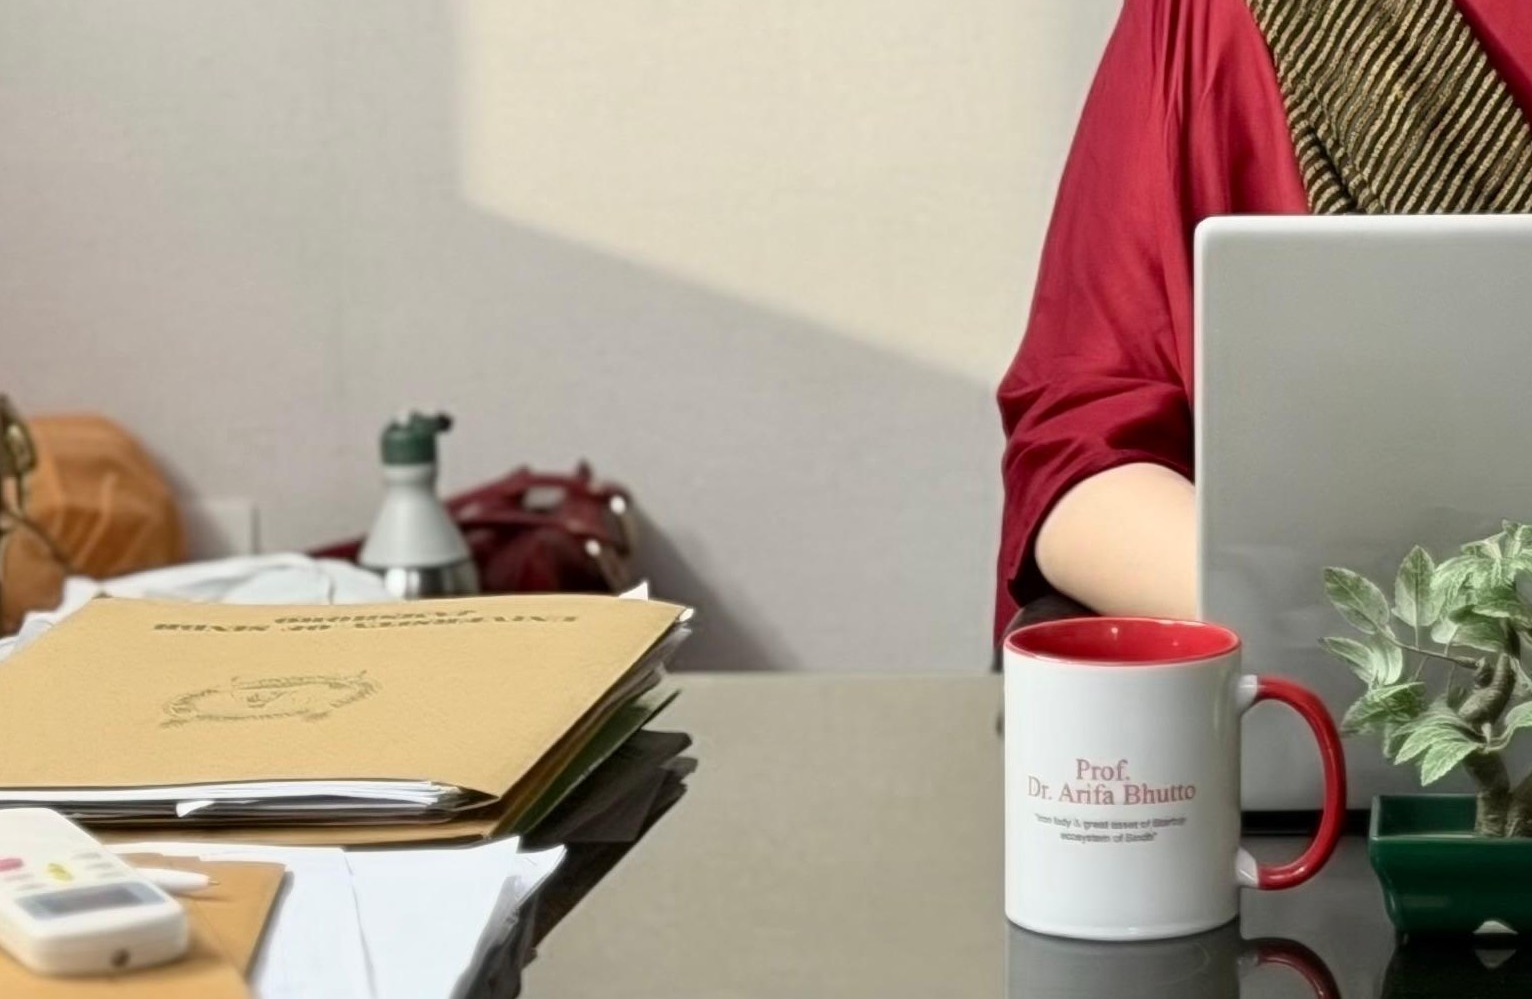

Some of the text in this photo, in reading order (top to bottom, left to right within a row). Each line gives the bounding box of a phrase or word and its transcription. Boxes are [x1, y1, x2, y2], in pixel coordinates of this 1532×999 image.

[1076, 758, 1131, 782] Prof.
[1028, 775, 1196, 806] Dr. Arifa Bhutto
